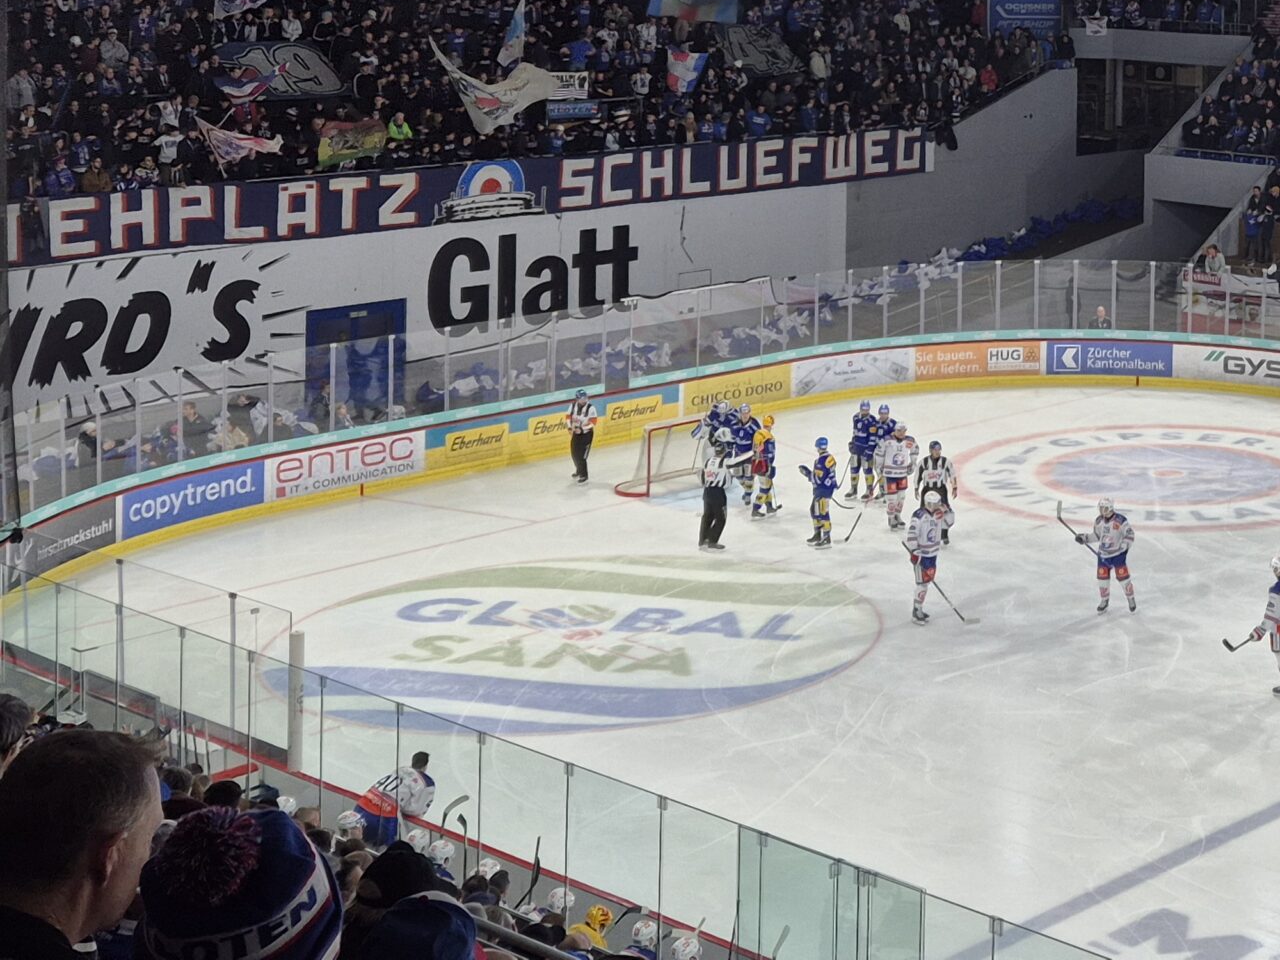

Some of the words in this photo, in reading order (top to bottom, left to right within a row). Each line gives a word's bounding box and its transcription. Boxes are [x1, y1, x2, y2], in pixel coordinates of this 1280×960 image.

[559, 127, 923, 208] SCHLUEFWEG
[427, 224, 639, 338] Glatt
[916, 352, 935, 363] Sie
[937, 350, 976, 362] bauen.
[989, 349, 1022, 362] HUG
[1087, 346, 1131, 359] Zürcher
[916, 364, 936, 376] Wir
[941, 362, 982, 375] liefern.
[1087, 358, 1165, 371] Kantonalbank
[691, 387, 741, 407] CHICCO
[611, 402, 659, 421] Eberhard
[450, 430, 504, 452] Eberhard
[290, 483, 300, 494] IT
[313, 461, 414, 490] COMMUNICATION
[128, 468, 256, 522] copytrend.
[391, 634, 693, 677] SANA
